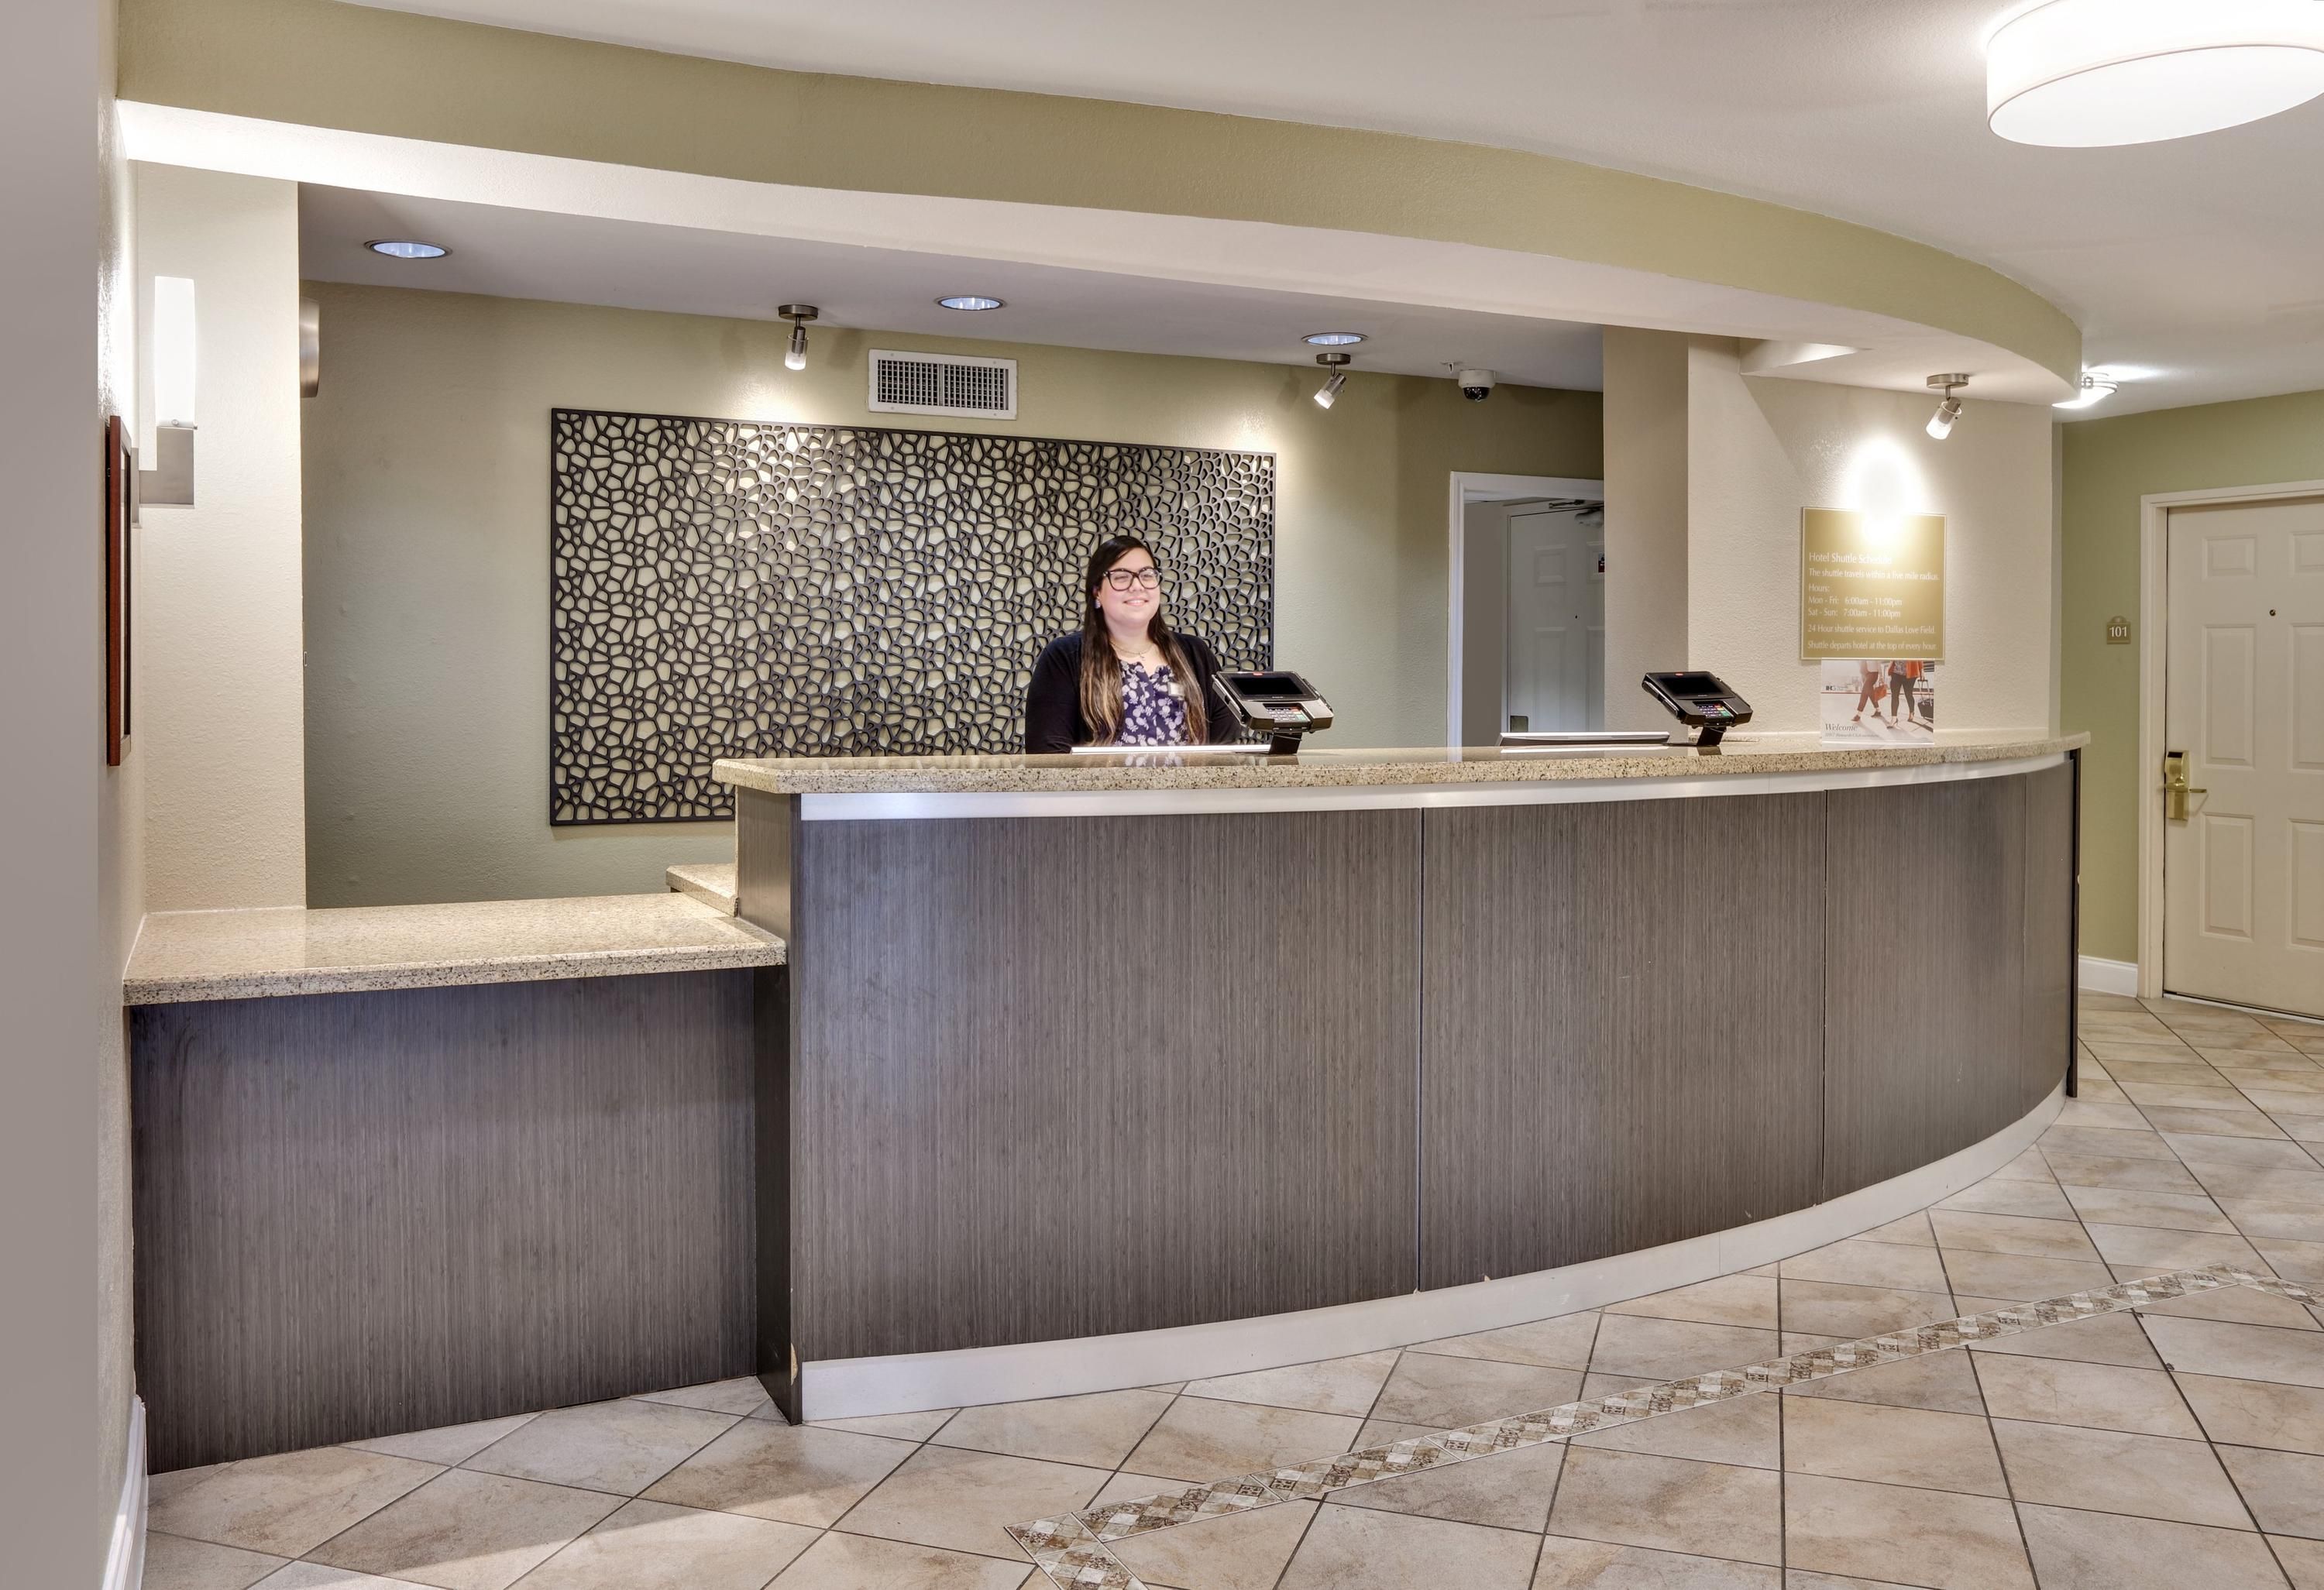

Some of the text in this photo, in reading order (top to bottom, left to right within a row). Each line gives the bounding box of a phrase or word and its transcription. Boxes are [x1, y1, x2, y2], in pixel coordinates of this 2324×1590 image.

[1809, 551, 1830, 562] Hotel
[1831, 552, 1857, 564] Shuttle
[1809, 568, 1820, 577] The
[1822, 568, 1843, 578] shuttle
[1808, 583, 1831, 592] Hours:
[1875, 597, 1903, 607] 11:00pm
[1808, 608, 1818, 616] Sat
[1844, 609, 1868, 617] 7:00am
[1874, 610, 1901, 620] 11:00pm
[1808, 624, 1816, 633] 24
[1817, 624, 1834, 633] Hour
[1834, 624, 1855, 633] shuttle
[2109, 626, 2127, 637] 101
[1808, 640, 1828, 649] Shuttle
[1830, 640, 1851, 651] departs
[1852, 640, 1868, 650] hotel
[1876, 641, 1886, 650] the
[1887, 642, 1897, 651] top
[1898, 641, 1905, 650] of
